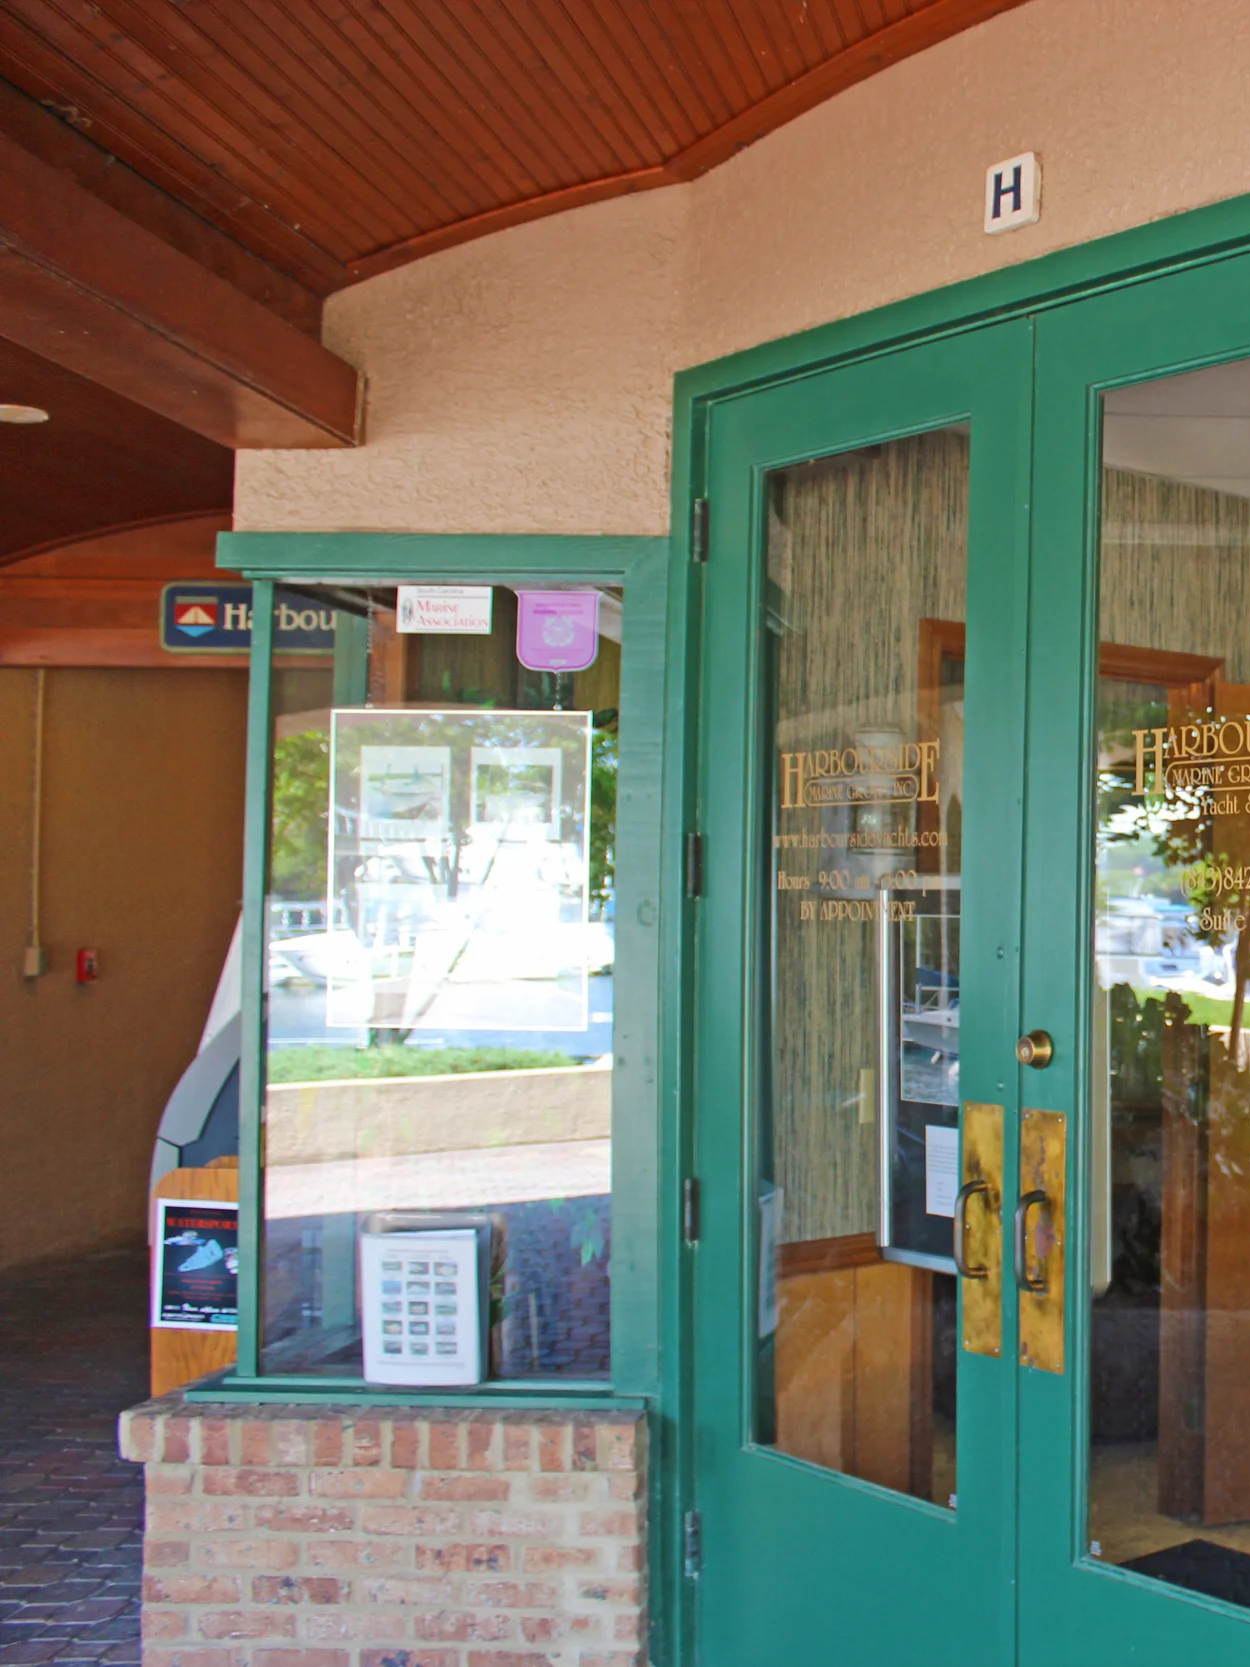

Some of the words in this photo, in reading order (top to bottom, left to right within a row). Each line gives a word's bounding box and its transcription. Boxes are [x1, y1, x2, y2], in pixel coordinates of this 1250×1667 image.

[992, 165, 1022, 219] H
[223, 603, 337, 631] Hbou
[781, 738, 940, 808] HARBOURSIDE
[1173, 766, 1223, 787] MARINE
[1201, 795, 1240, 816] Yacht
[818, 870, 851, 890] 9:00
[800, 901, 816, 920] BY
[820, 901, 916, 921] APPOINTENT
